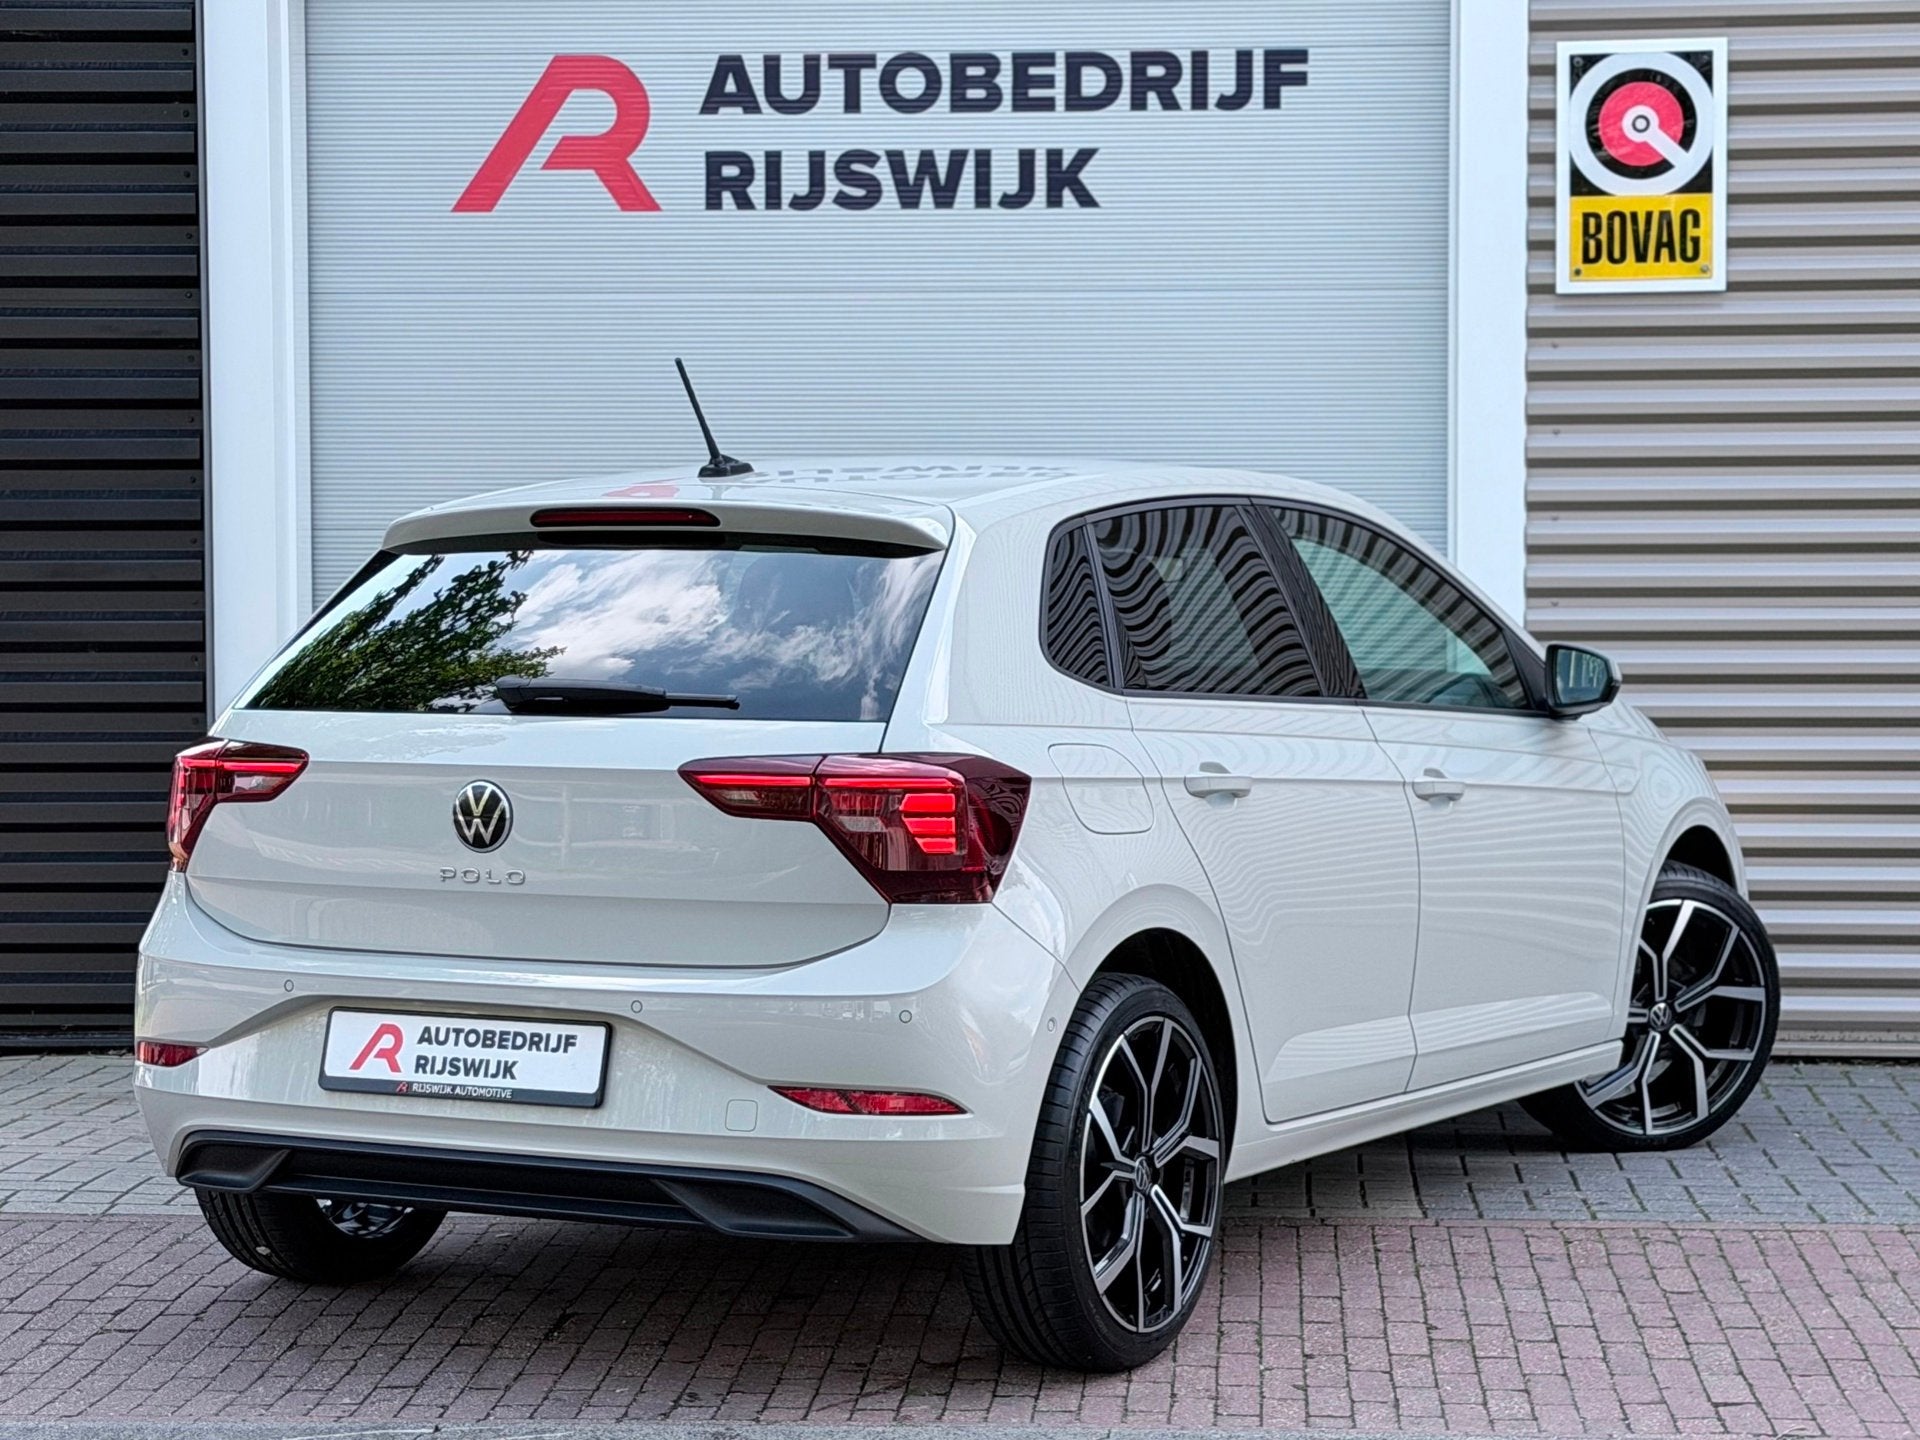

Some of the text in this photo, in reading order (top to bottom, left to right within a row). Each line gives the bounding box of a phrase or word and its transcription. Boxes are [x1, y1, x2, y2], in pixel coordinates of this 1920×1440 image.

[700, 48, 1310, 115] AUTOBEDRIJF
[704, 148, 1101, 211] RIJSWIJK
[1582, 209, 1700, 264] BOVAG
[439, 866, 526, 885] POLO
[417, 1026, 577, 1053] AUTOBEDRIJF
[414, 1055, 518, 1080] RIJSWIJK
[412, 1083, 512, 1099] RIJSWIJK AUTOMOTIVE
